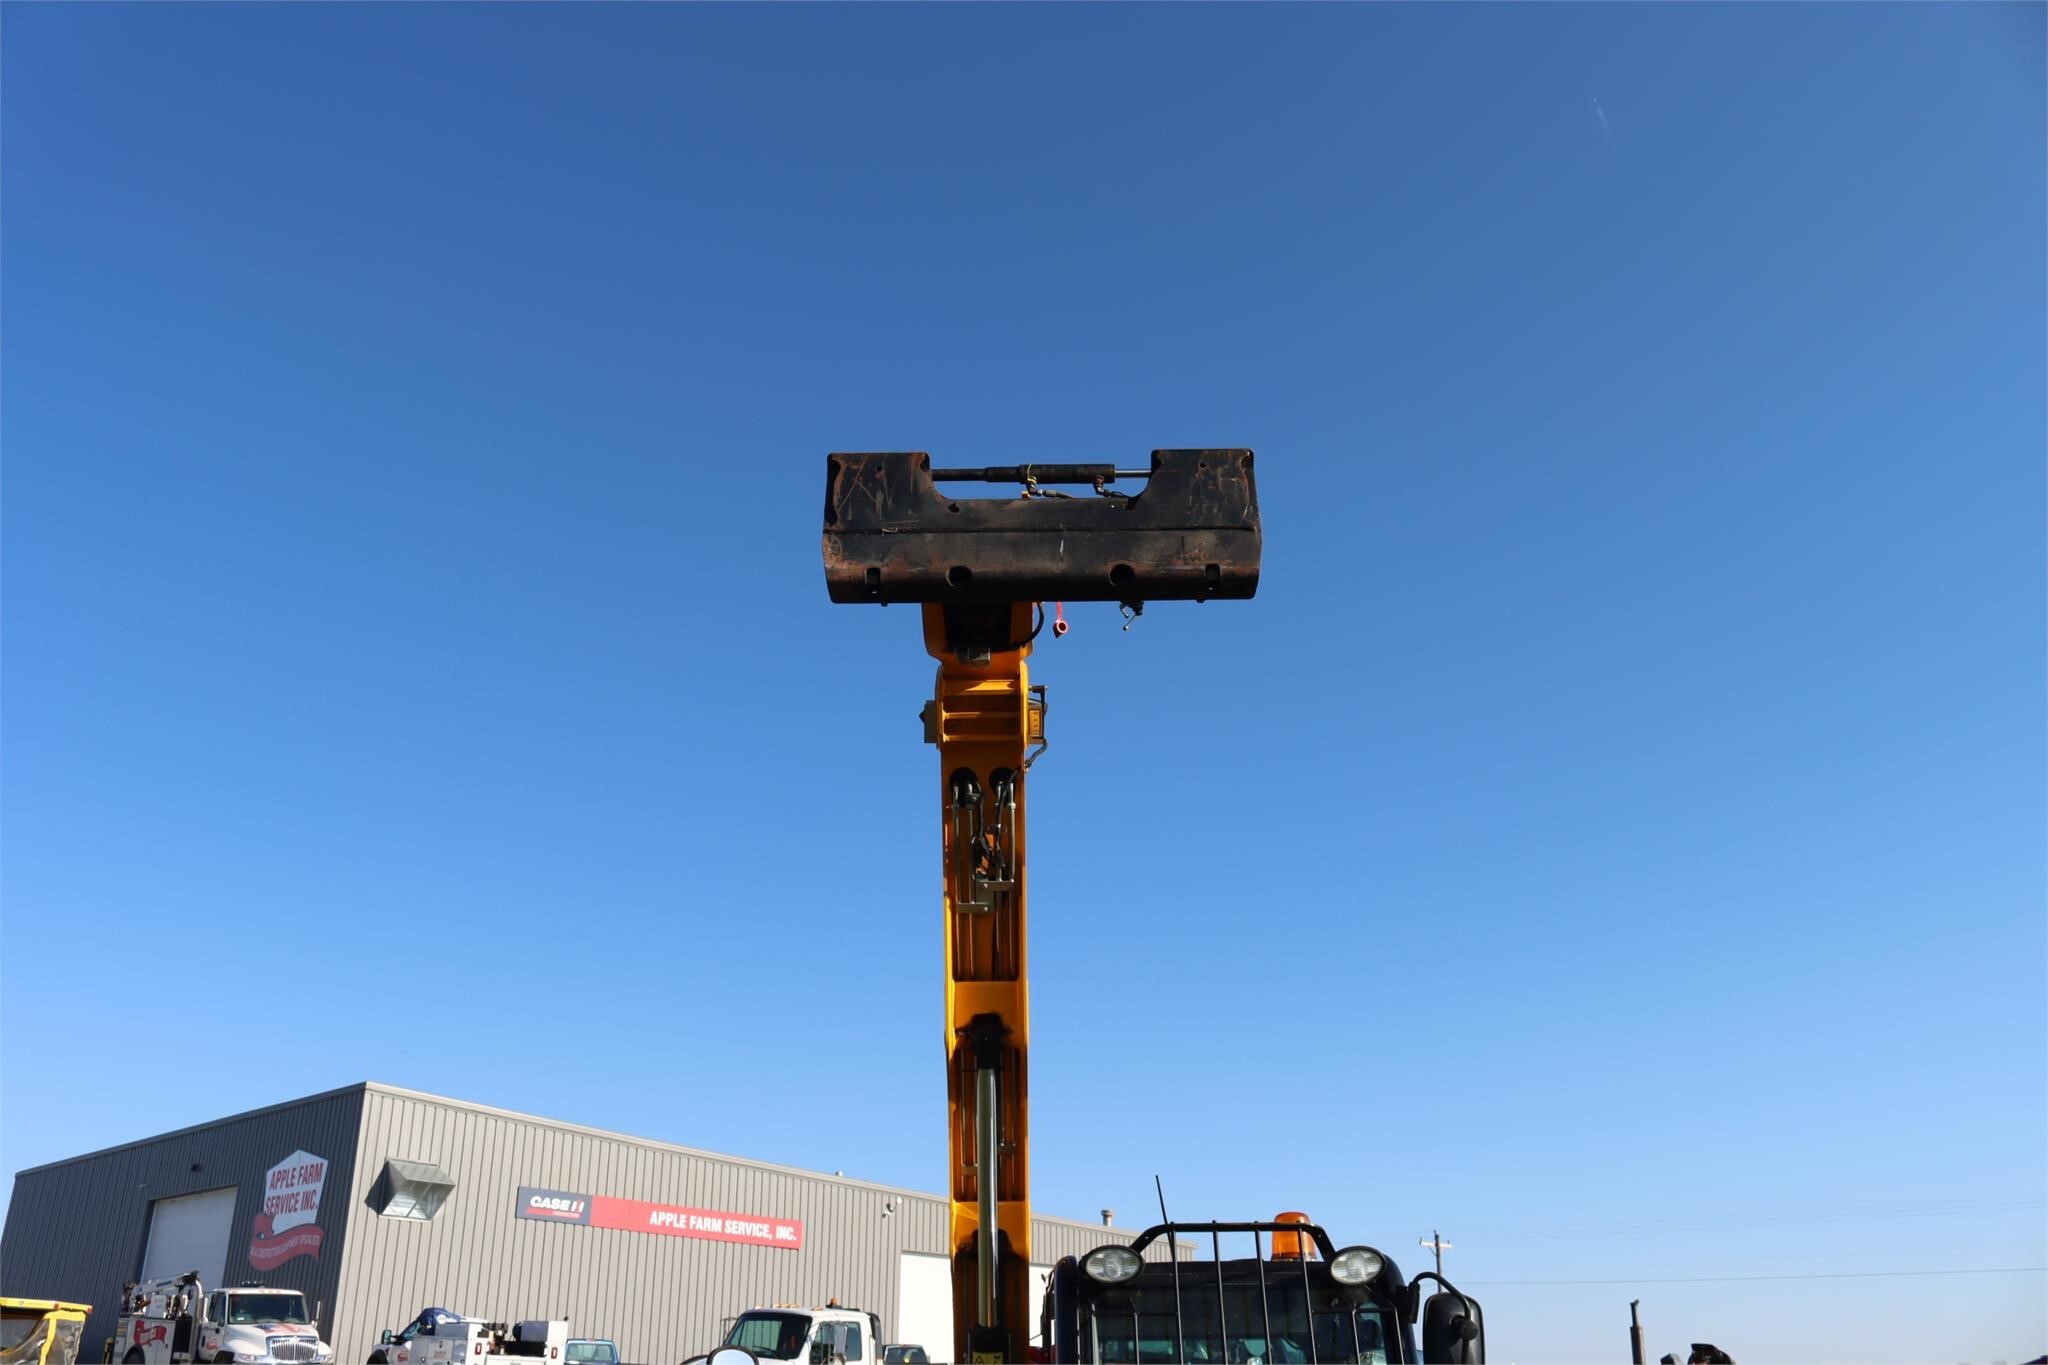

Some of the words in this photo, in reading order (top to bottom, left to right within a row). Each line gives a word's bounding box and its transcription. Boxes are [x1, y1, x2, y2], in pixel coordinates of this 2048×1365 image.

[269, 1167, 297, 1191] APPLE
[297, 1162, 324, 1185] FARM
[264, 1193, 300, 1216] SERVICE
[301, 1189, 318, 1211] INC.
[530, 1196, 571, 1211] CASE
[649, 1210, 687, 1229] APPLE
[689, 1216, 722, 1233] FARM
[724, 1219, 773, 1240] SERVICE,
[776, 1225, 797, 1241] INC.
